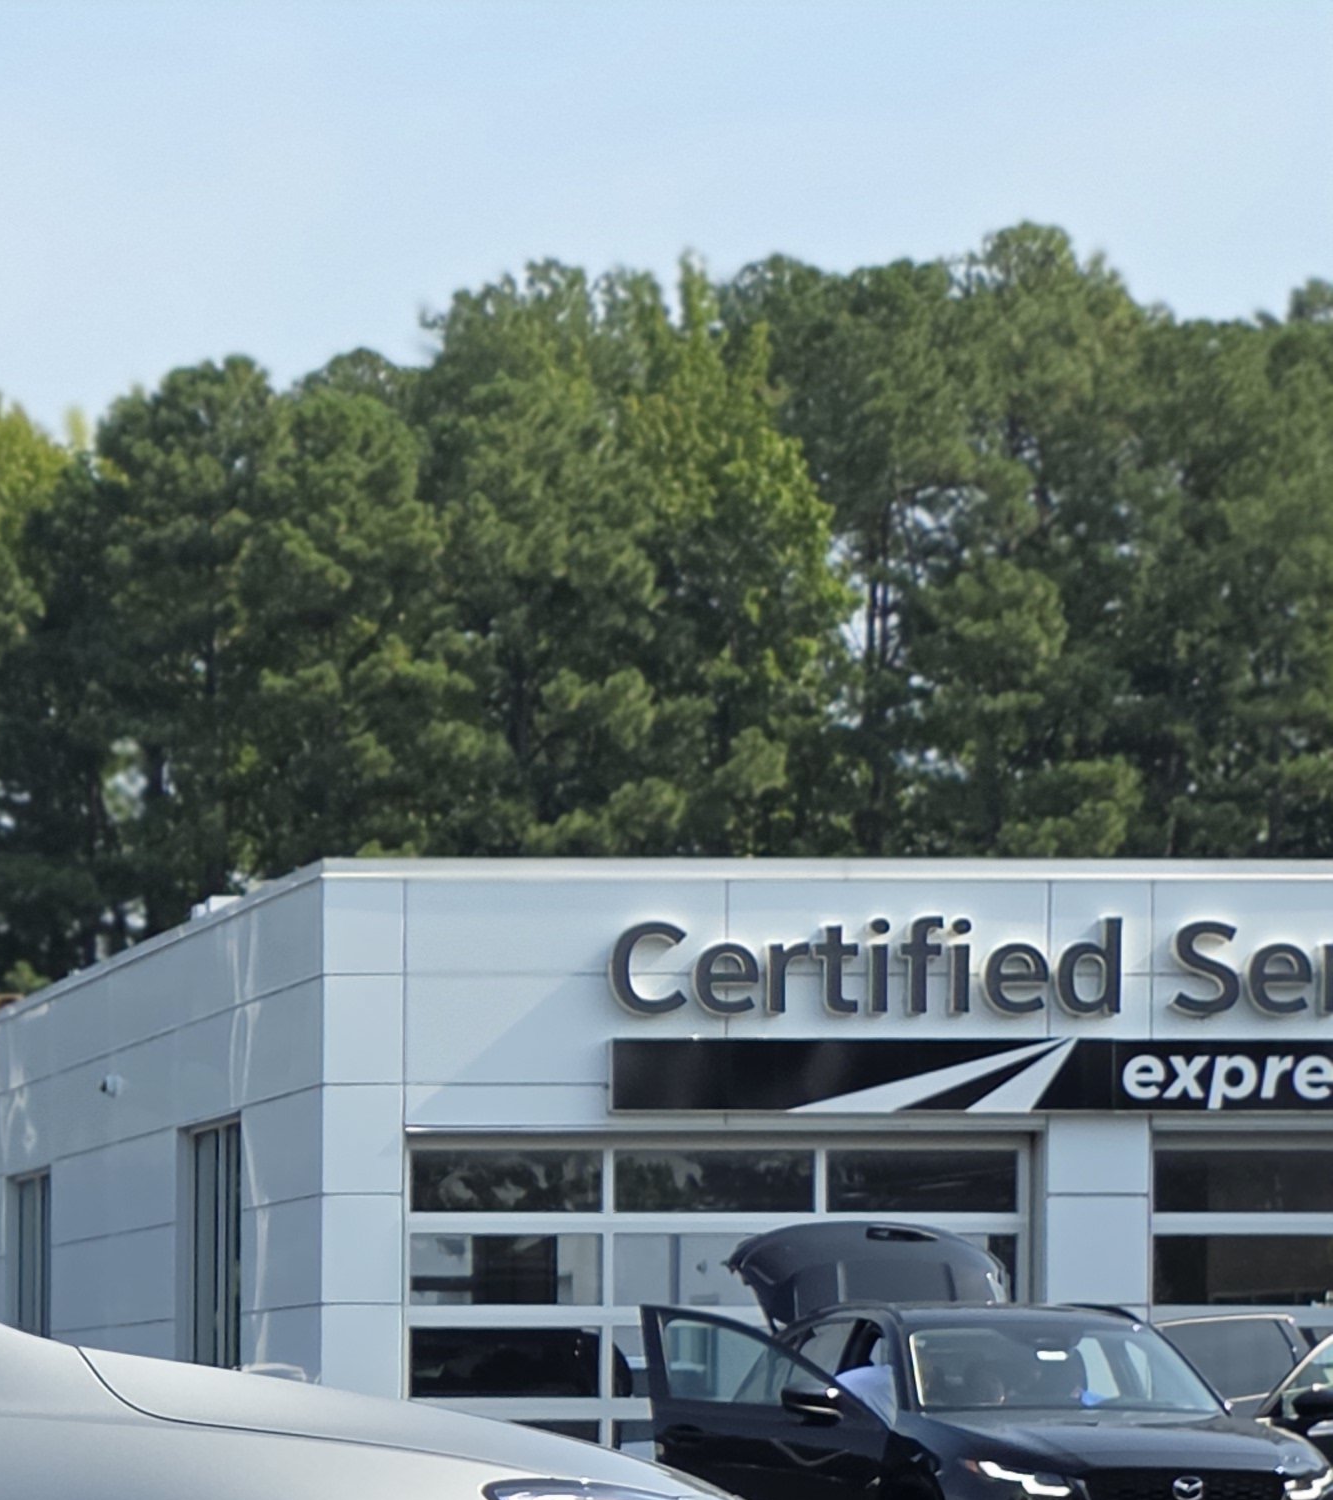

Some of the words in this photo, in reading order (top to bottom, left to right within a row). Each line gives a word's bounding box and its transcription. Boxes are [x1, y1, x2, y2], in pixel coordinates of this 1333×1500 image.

[612, 917, 1122, 1017] Certified
[1170, 920, 1333, 1018] Se
[1122, 1054, 1333, 1109] expre
